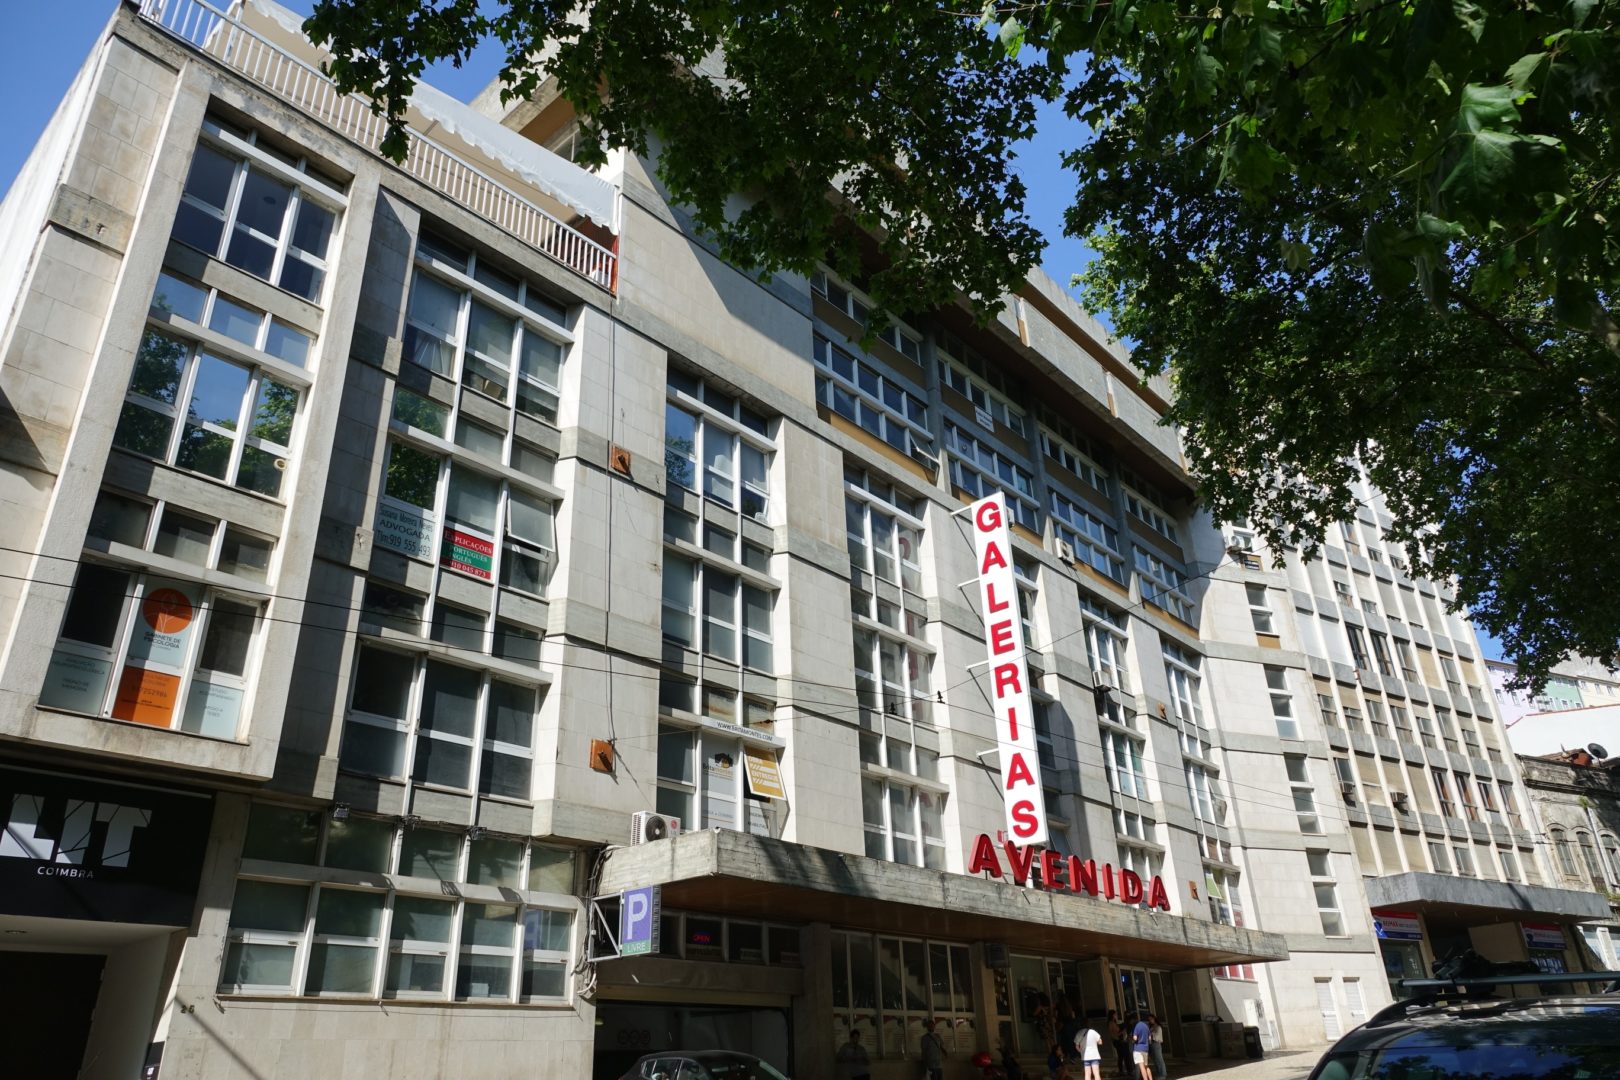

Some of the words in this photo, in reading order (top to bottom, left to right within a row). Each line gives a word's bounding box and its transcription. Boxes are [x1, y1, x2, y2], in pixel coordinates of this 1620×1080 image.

[380, 519, 430, 541] ADVOGADA
[404, 539, 417, 552] 555
[975, 501, 1039, 839] GALERIAS
[37, 866, 94, 879] COIMBRA
[968, 833, 1171, 911] AVENIDA
[627, 893, 648, 940] P
[627, 942, 646, 953] LIVRE
